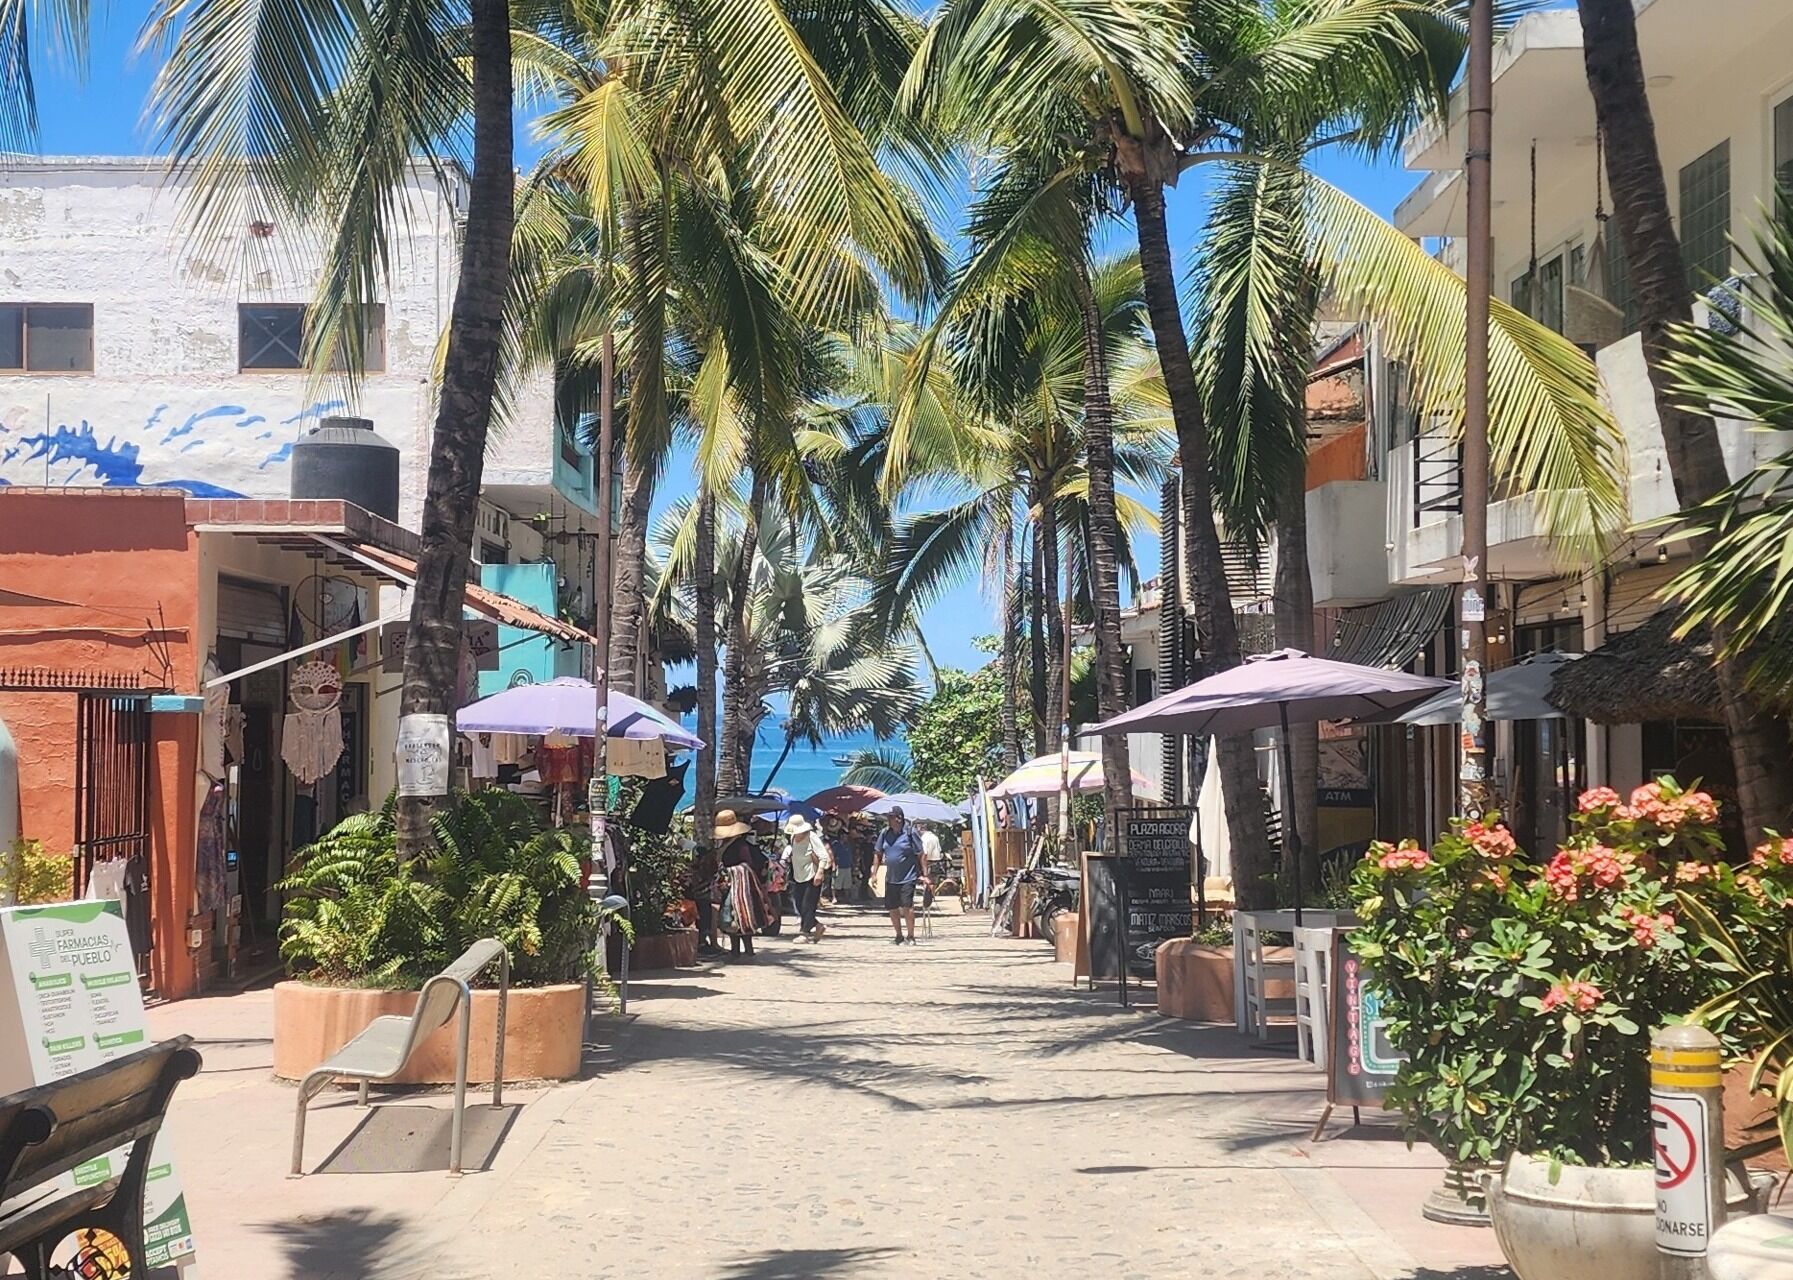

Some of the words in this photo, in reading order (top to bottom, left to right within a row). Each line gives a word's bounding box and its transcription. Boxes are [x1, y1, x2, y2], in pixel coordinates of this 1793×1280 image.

[342, 717, 352, 802] PHARMAC
[1325, 791, 1351, 801] ATM
[1130, 823, 1158, 835] PLAZA
[1159, 823, 1187, 835] AGORA
[55, 928, 74, 938] SUPER
[57, 934, 109, 951] FARMACIAS
[71, 950, 112, 966] PUEBLO
[1346, 962, 1359, 1074] VINTAGE
[1656, 1220, 1705, 1237] IONARSE
